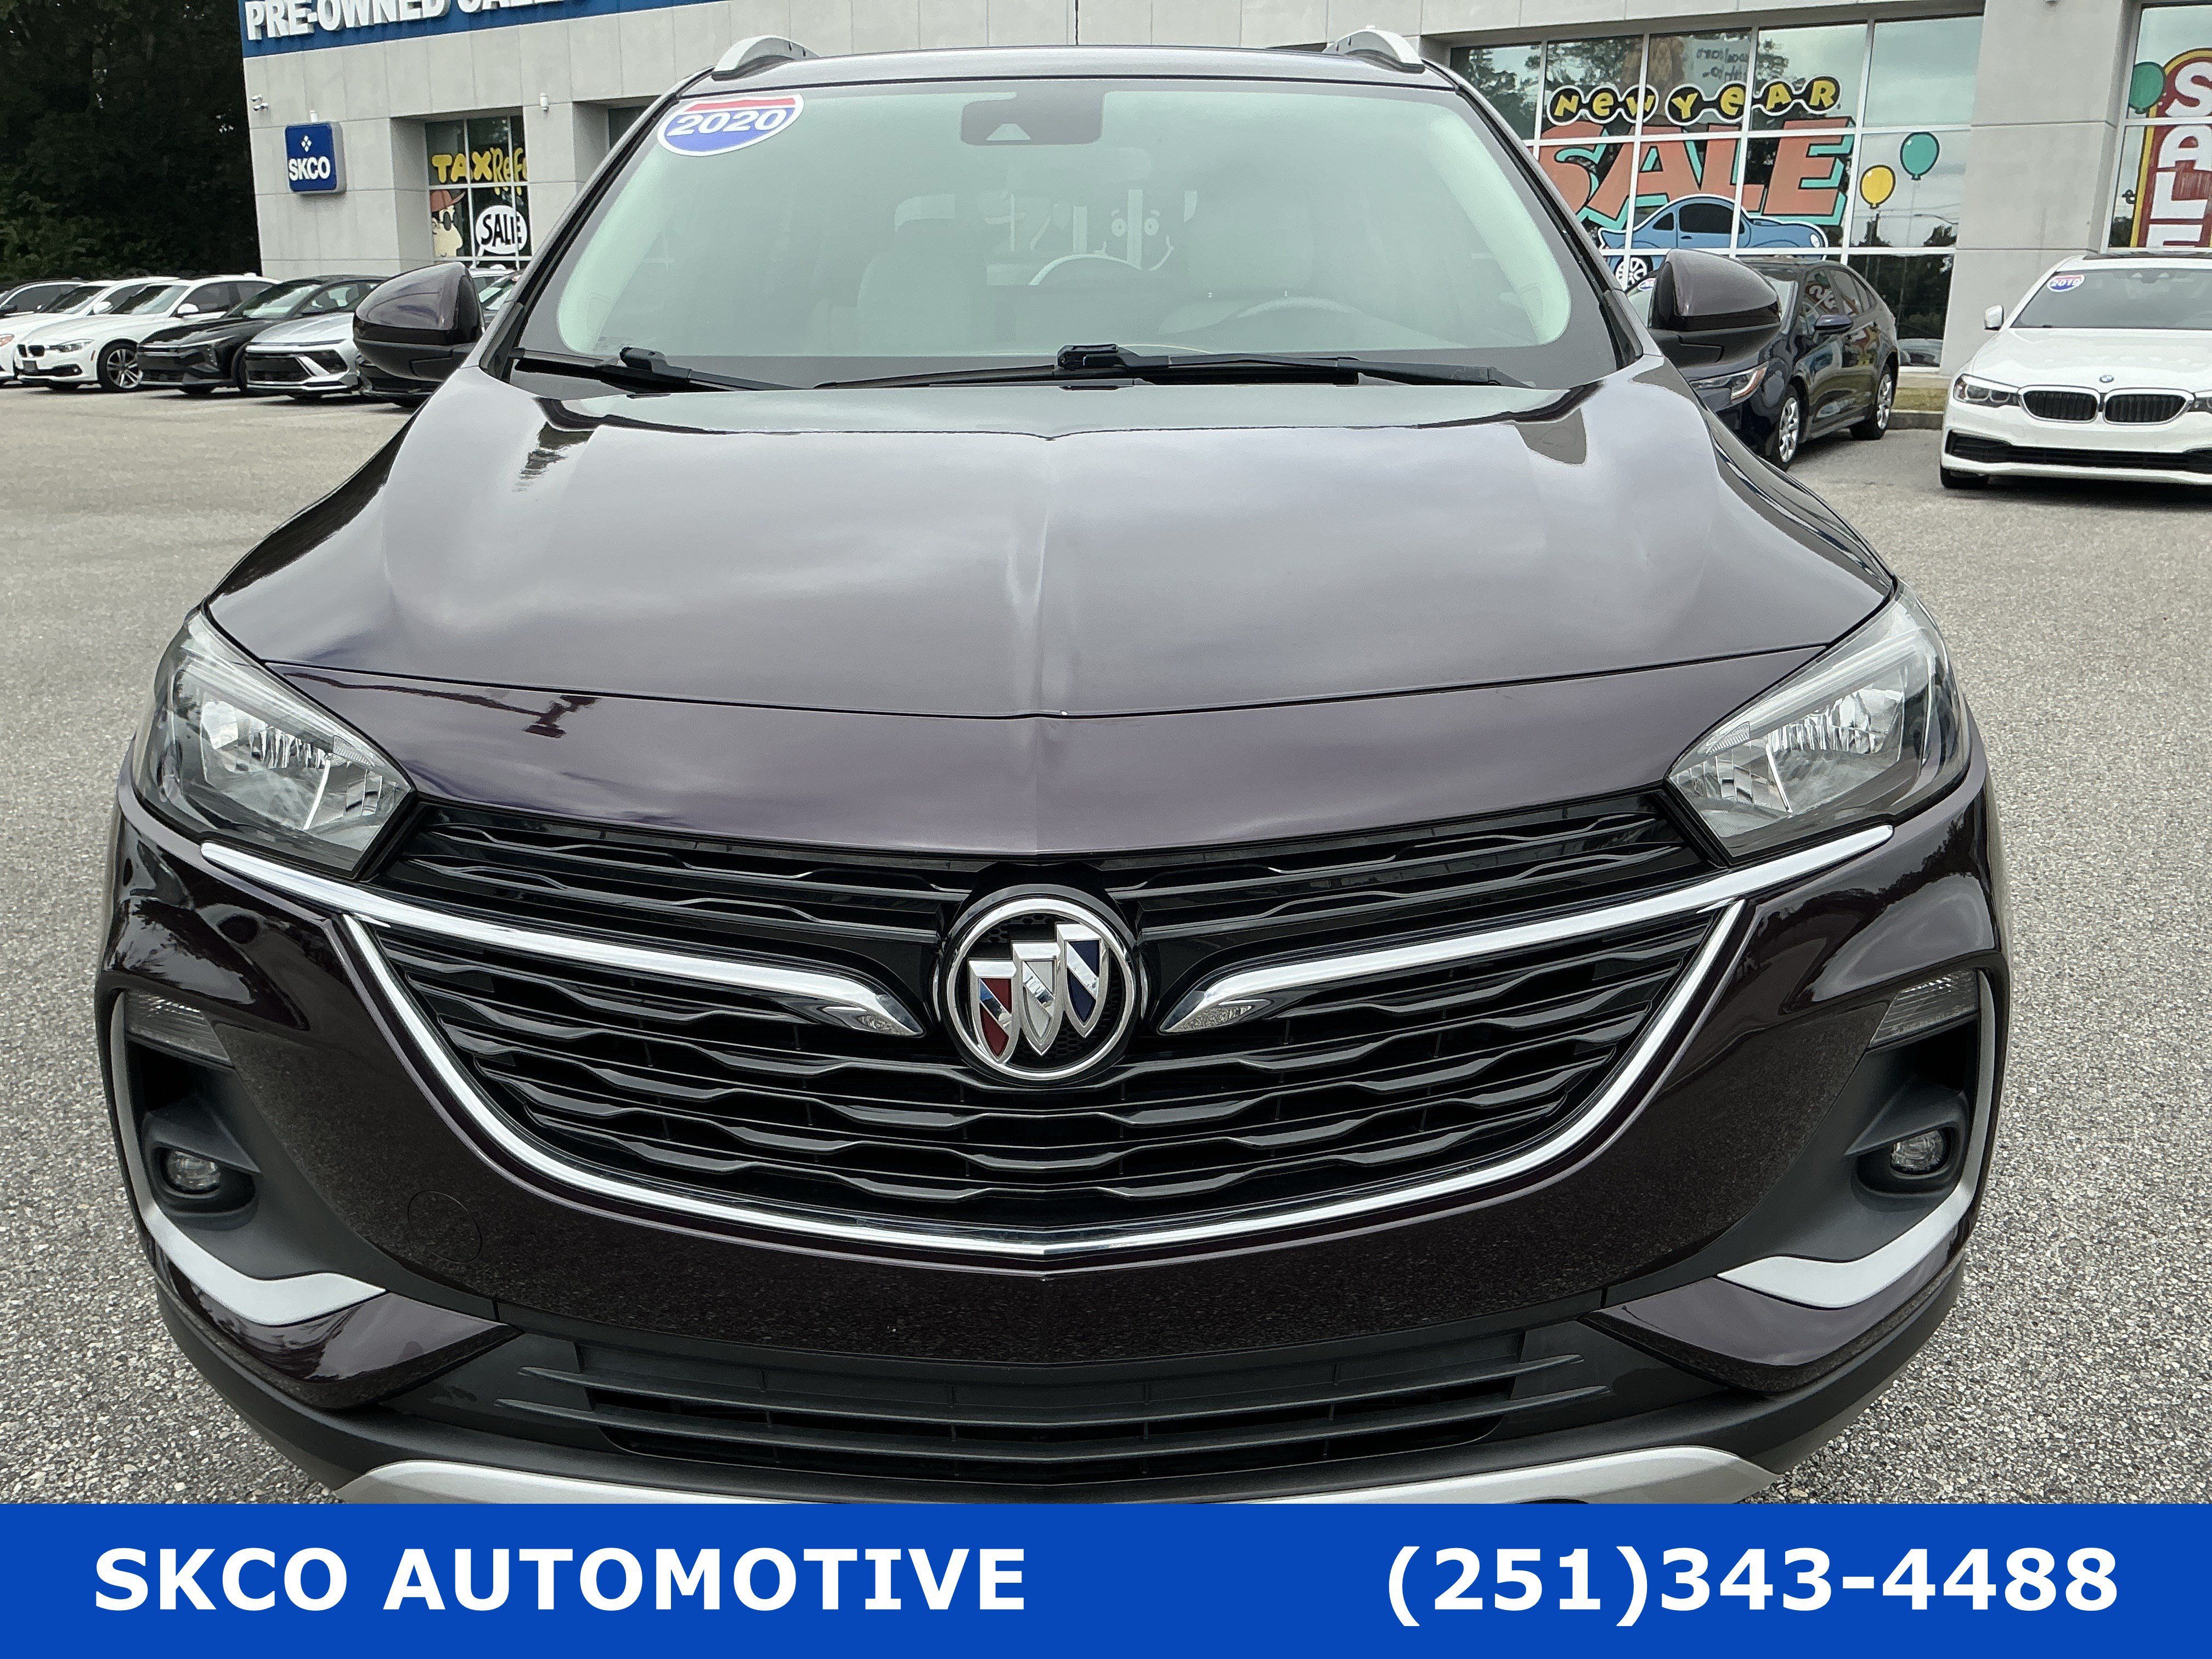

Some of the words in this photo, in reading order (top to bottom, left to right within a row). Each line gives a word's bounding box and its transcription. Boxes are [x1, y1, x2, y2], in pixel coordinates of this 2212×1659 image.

[667, 109, 787, 137] 2020
[289, 156, 331, 182] SKCO
[432, 151, 493, 183] TAX
[1527, 117, 1855, 226] SALE
[481, 213, 521, 247] SALE
